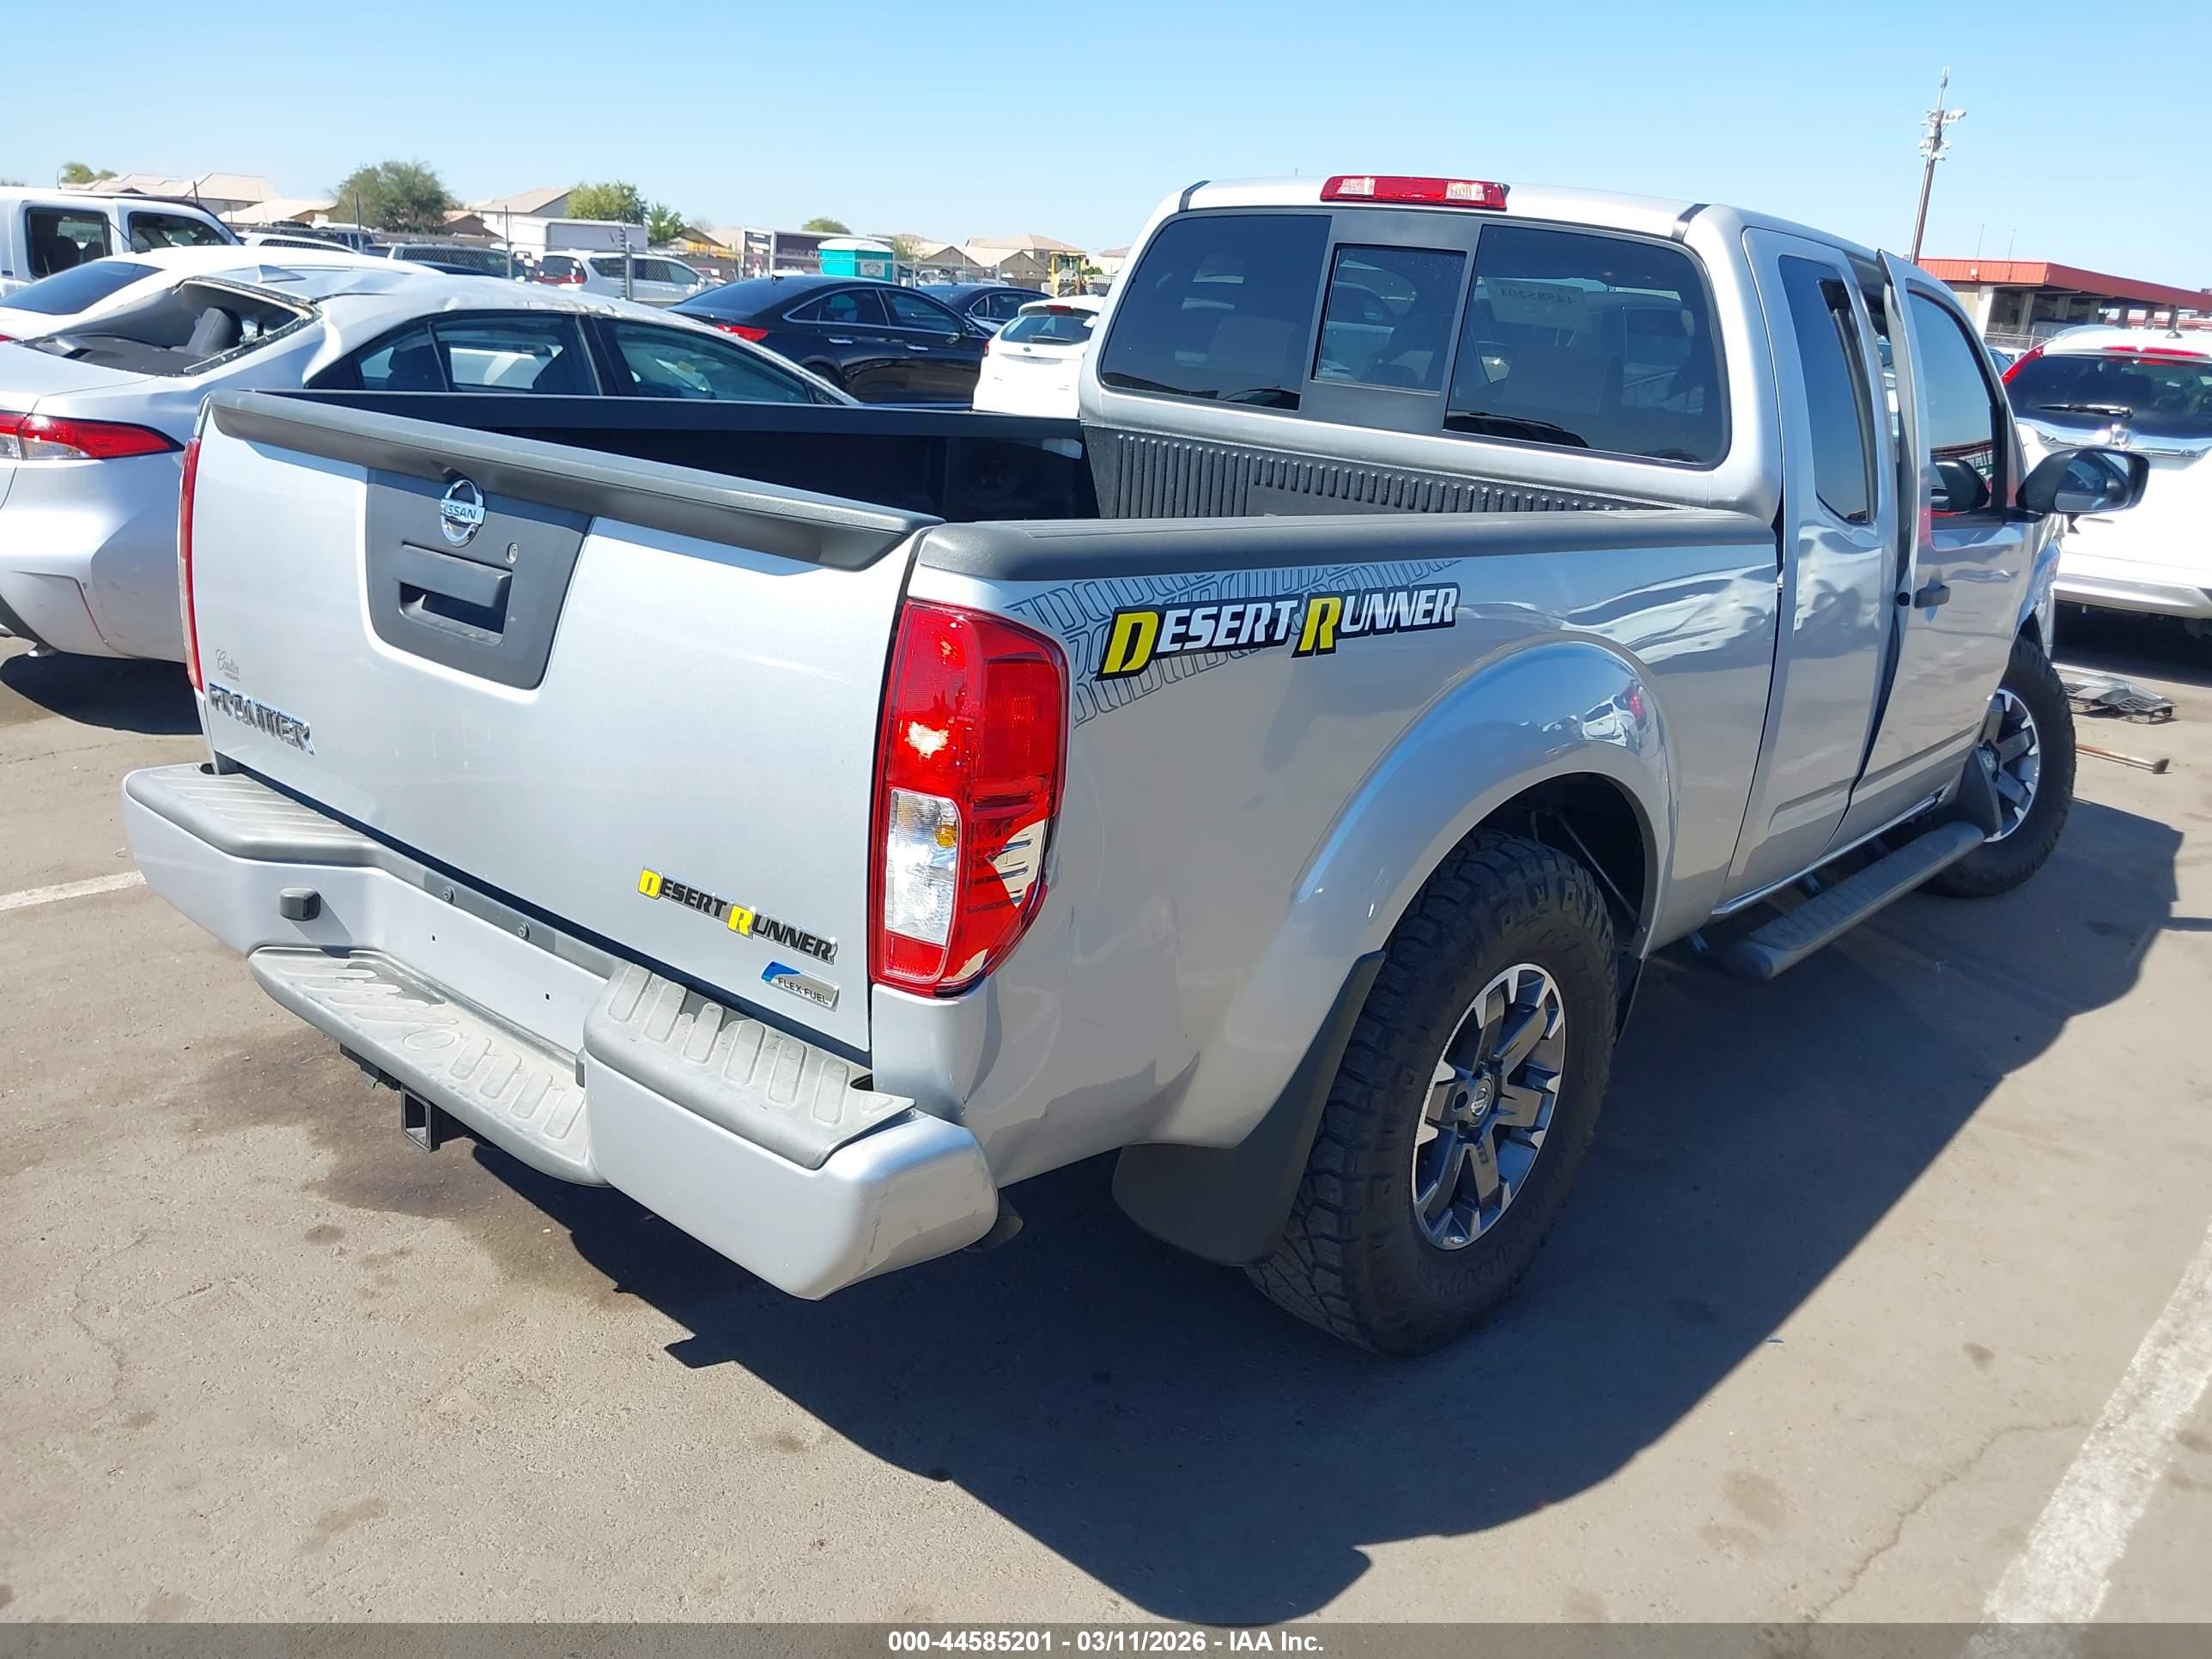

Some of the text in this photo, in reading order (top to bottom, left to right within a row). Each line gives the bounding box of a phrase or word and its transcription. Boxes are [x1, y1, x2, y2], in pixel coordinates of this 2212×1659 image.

[1102, 586, 1458, 674] DESERT RUNNER
[209, 683, 315, 756] FRONTIER
[638, 868, 836, 963] DESERT RUNNER
[778, 976, 829, 1006] FLEX FUEL
